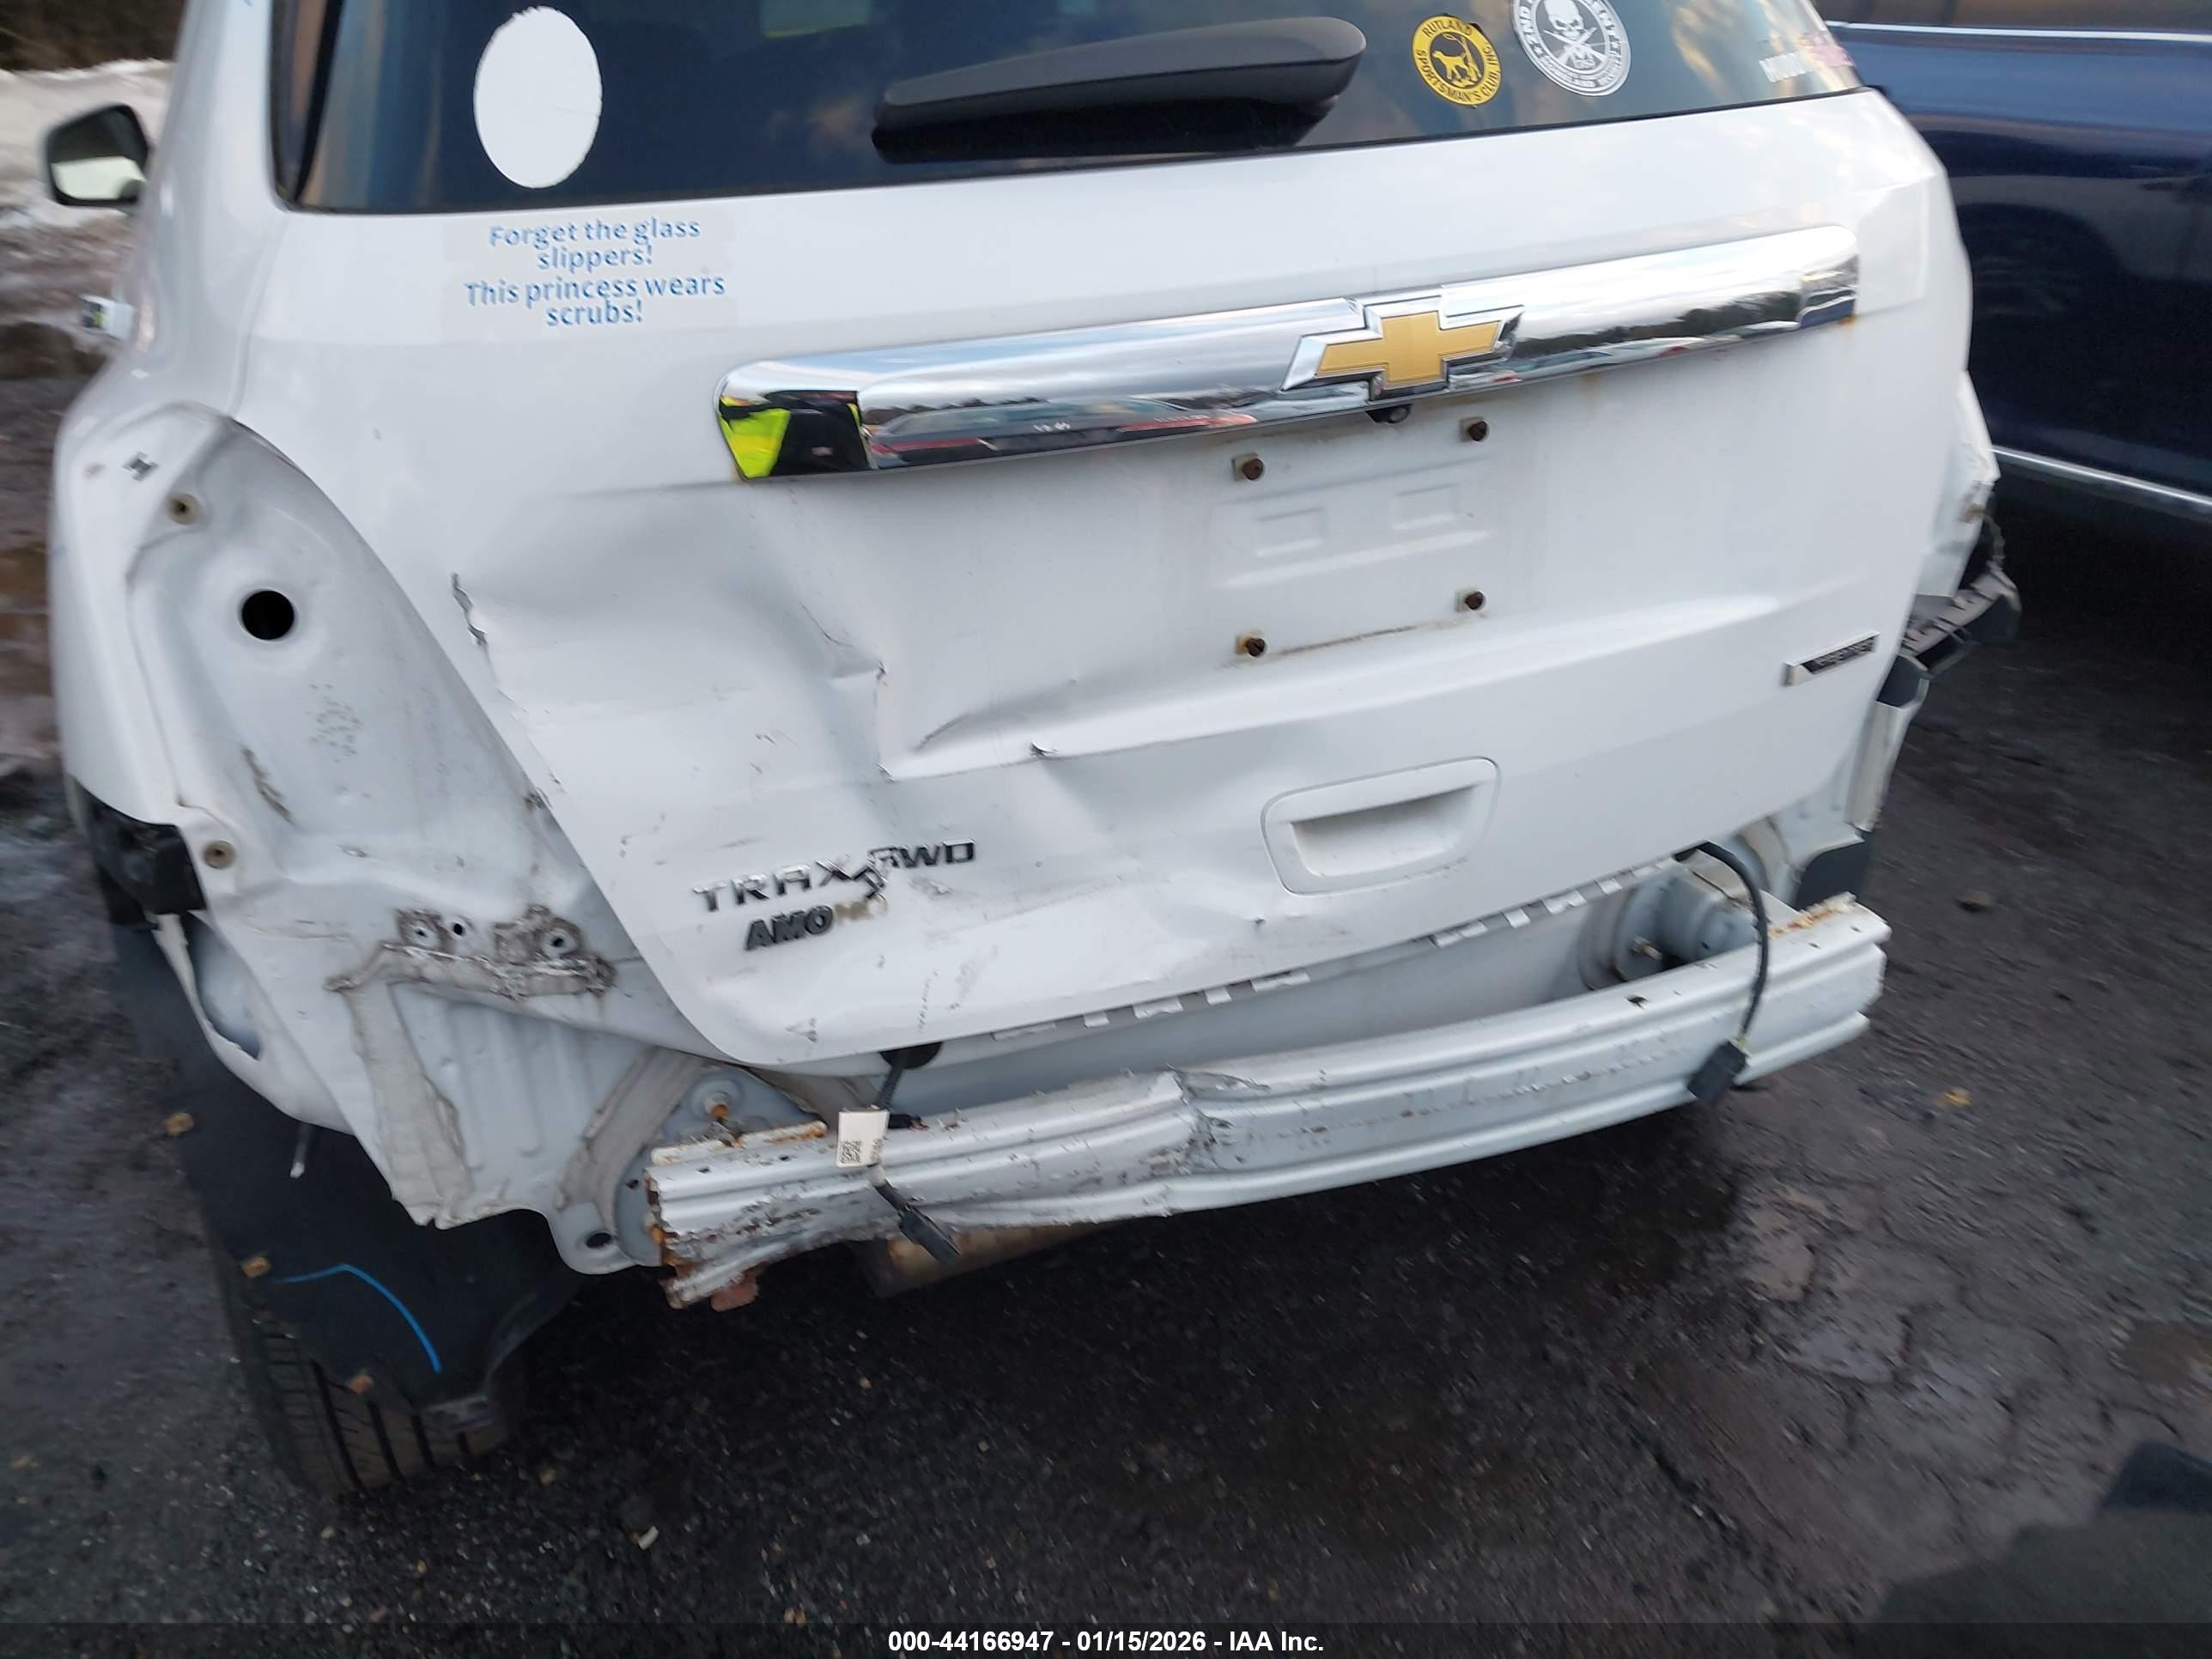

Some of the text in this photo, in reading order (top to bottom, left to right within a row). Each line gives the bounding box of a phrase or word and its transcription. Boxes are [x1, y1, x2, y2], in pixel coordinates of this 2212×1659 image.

[489, 215, 701, 251] Forget the glass
[537, 244, 653, 275] slippers!
[464, 274, 726, 310] This princess wears
[545, 299, 644, 327] scrubs!
[692, 857, 855, 913] TRAX
[744, 904, 834, 951] AMO
